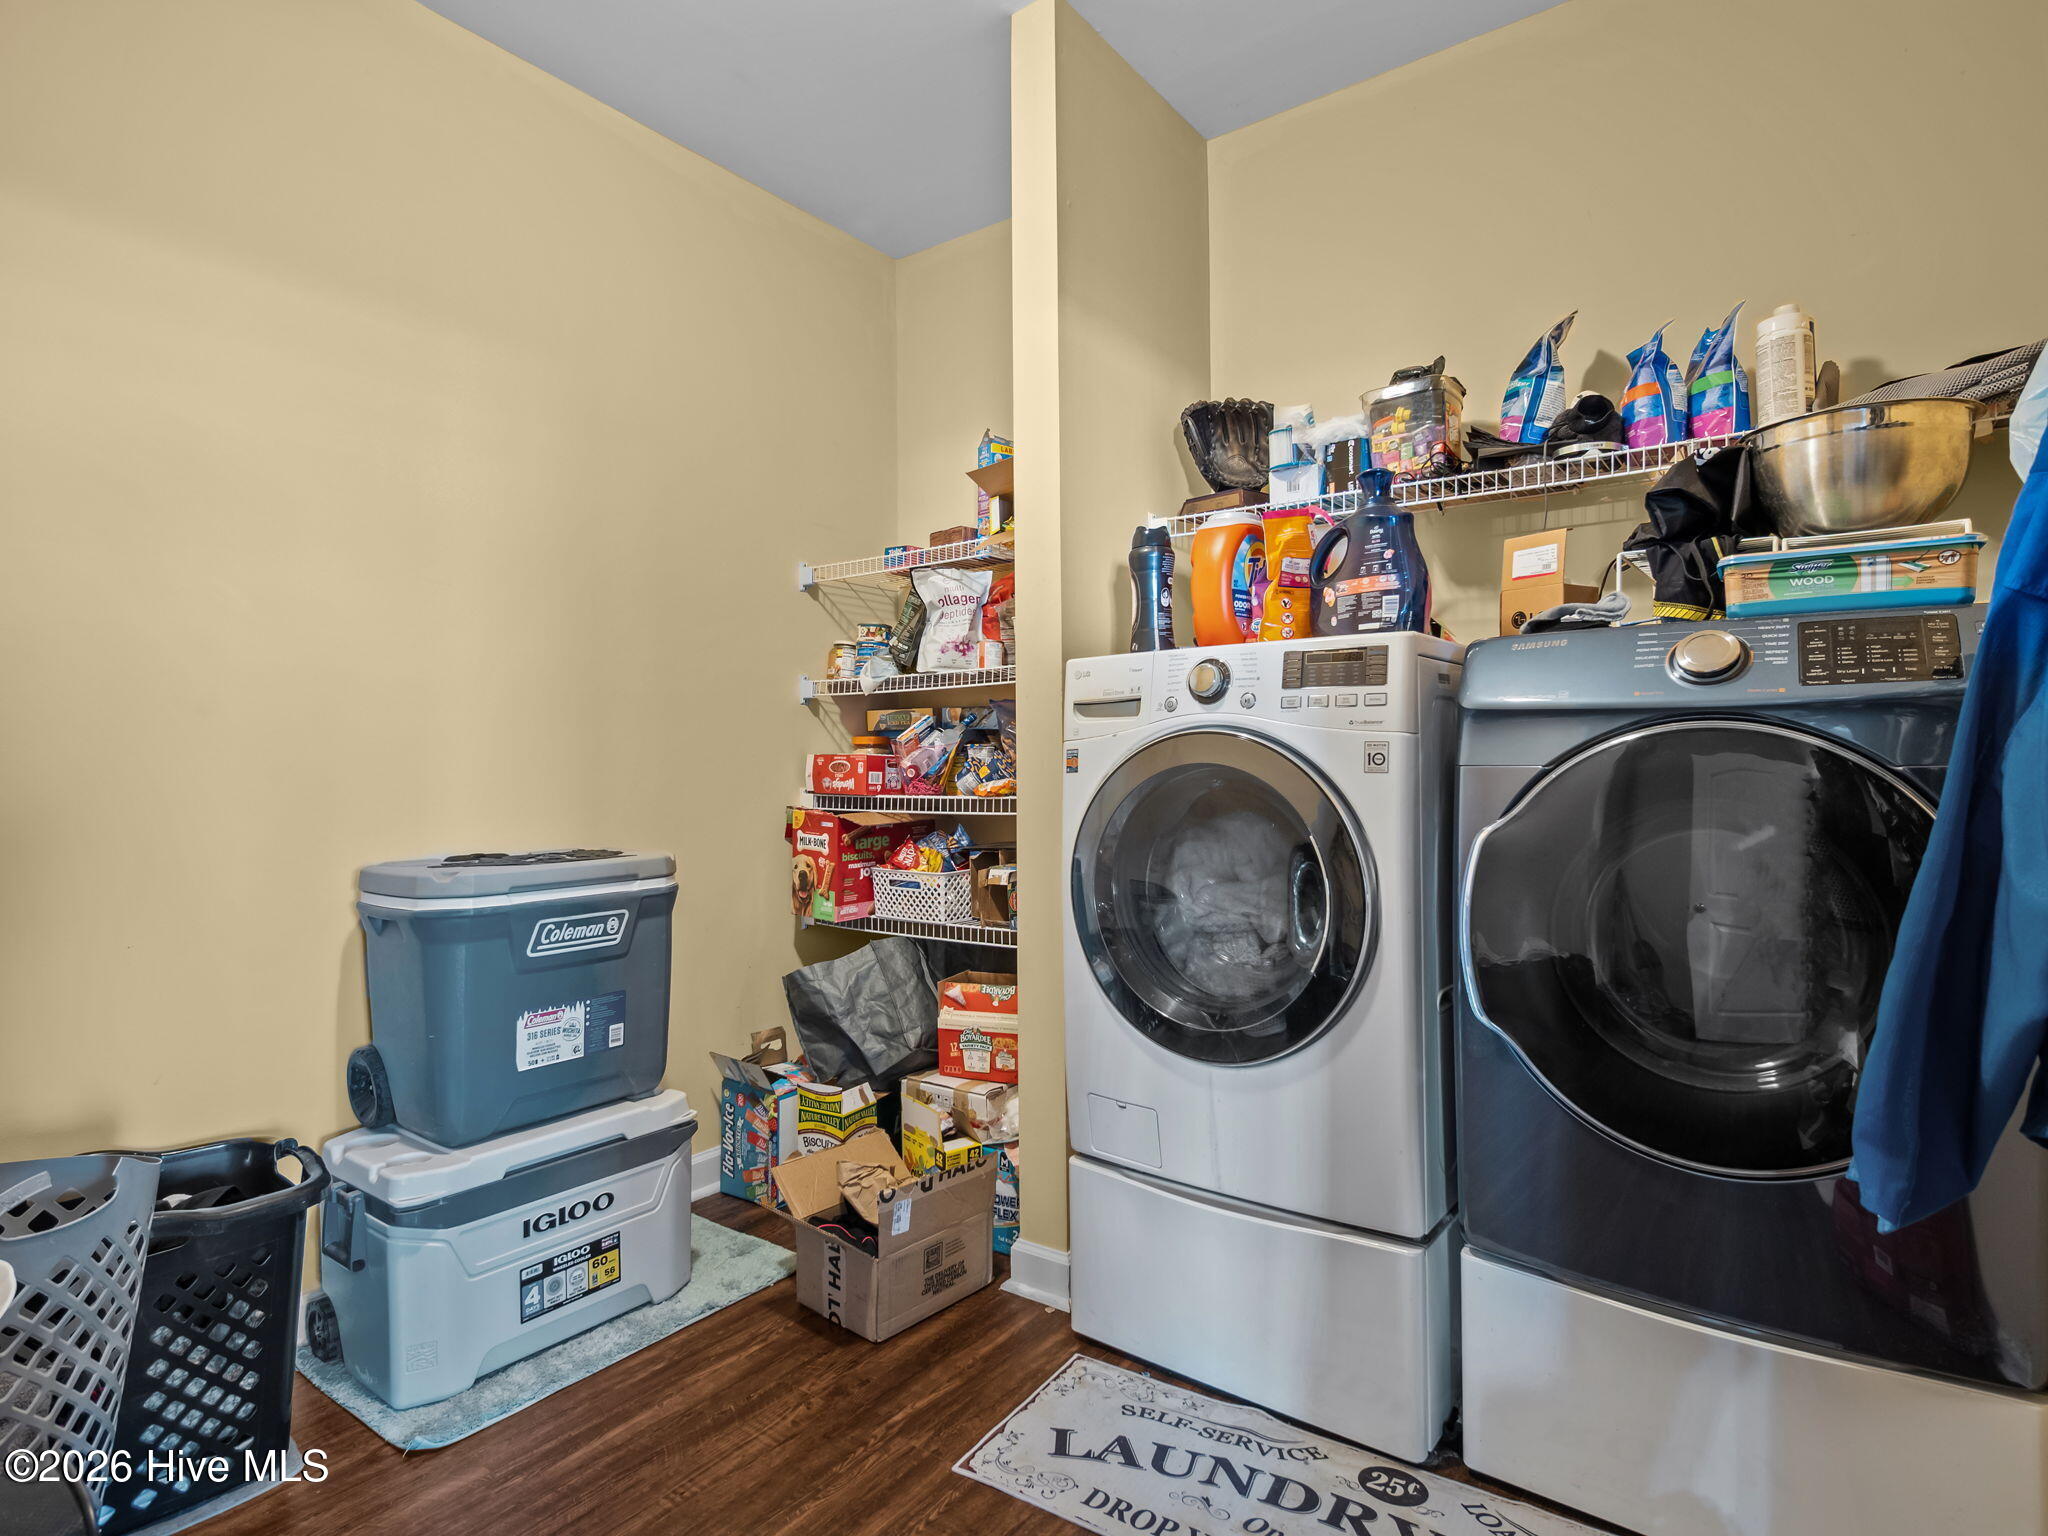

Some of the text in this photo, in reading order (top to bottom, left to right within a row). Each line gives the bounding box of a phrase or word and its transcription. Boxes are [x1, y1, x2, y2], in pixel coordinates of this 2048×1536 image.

[1789, 559, 1834, 574] Swiffer
[1789, 575, 1834, 586] WOOD
[938, 594, 981, 608] ollagen
[1511, 639, 1568, 651] SAMSUNG
[1367, 752, 1386, 766] 10
[799, 836, 827, 850] MILK-BONE
[855, 835, 890, 850] large
[848, 861, 876, 869] maximum
[859, 868, 873, 880] jo
[541, 922, 604, 944] Coleman
[981, 984, 1016, 995] BOYARDEE
[527, 1013, 558, 1025] Coleman
[526, 1026, 561, 1041] 316 SERIES
[959, 1033, 992, 1045] BOYARDEE
[801, 1110, 841, 1129] NATURE VALLEY
[844, 1106, 876, 1128] NATURE VALLEY
[969, 1148, 980, 1158] 42
[994, 1194, 1019, 1209] OWE
[523, 1192, 615, 1238] IGLOO
[553, 1245, 591, 1266] IGLOO
[592, 1255, 608, 1269] 60
[604, 1266, 616, 1276] 56
[524, 1285, 541, 1306] 4
[1121, 1404, 1330, 1462] SELF-SERVICE
[1365, 1470, 1421, 1497] 25¢
[1080, 1487, 1180, 1536] DROP
